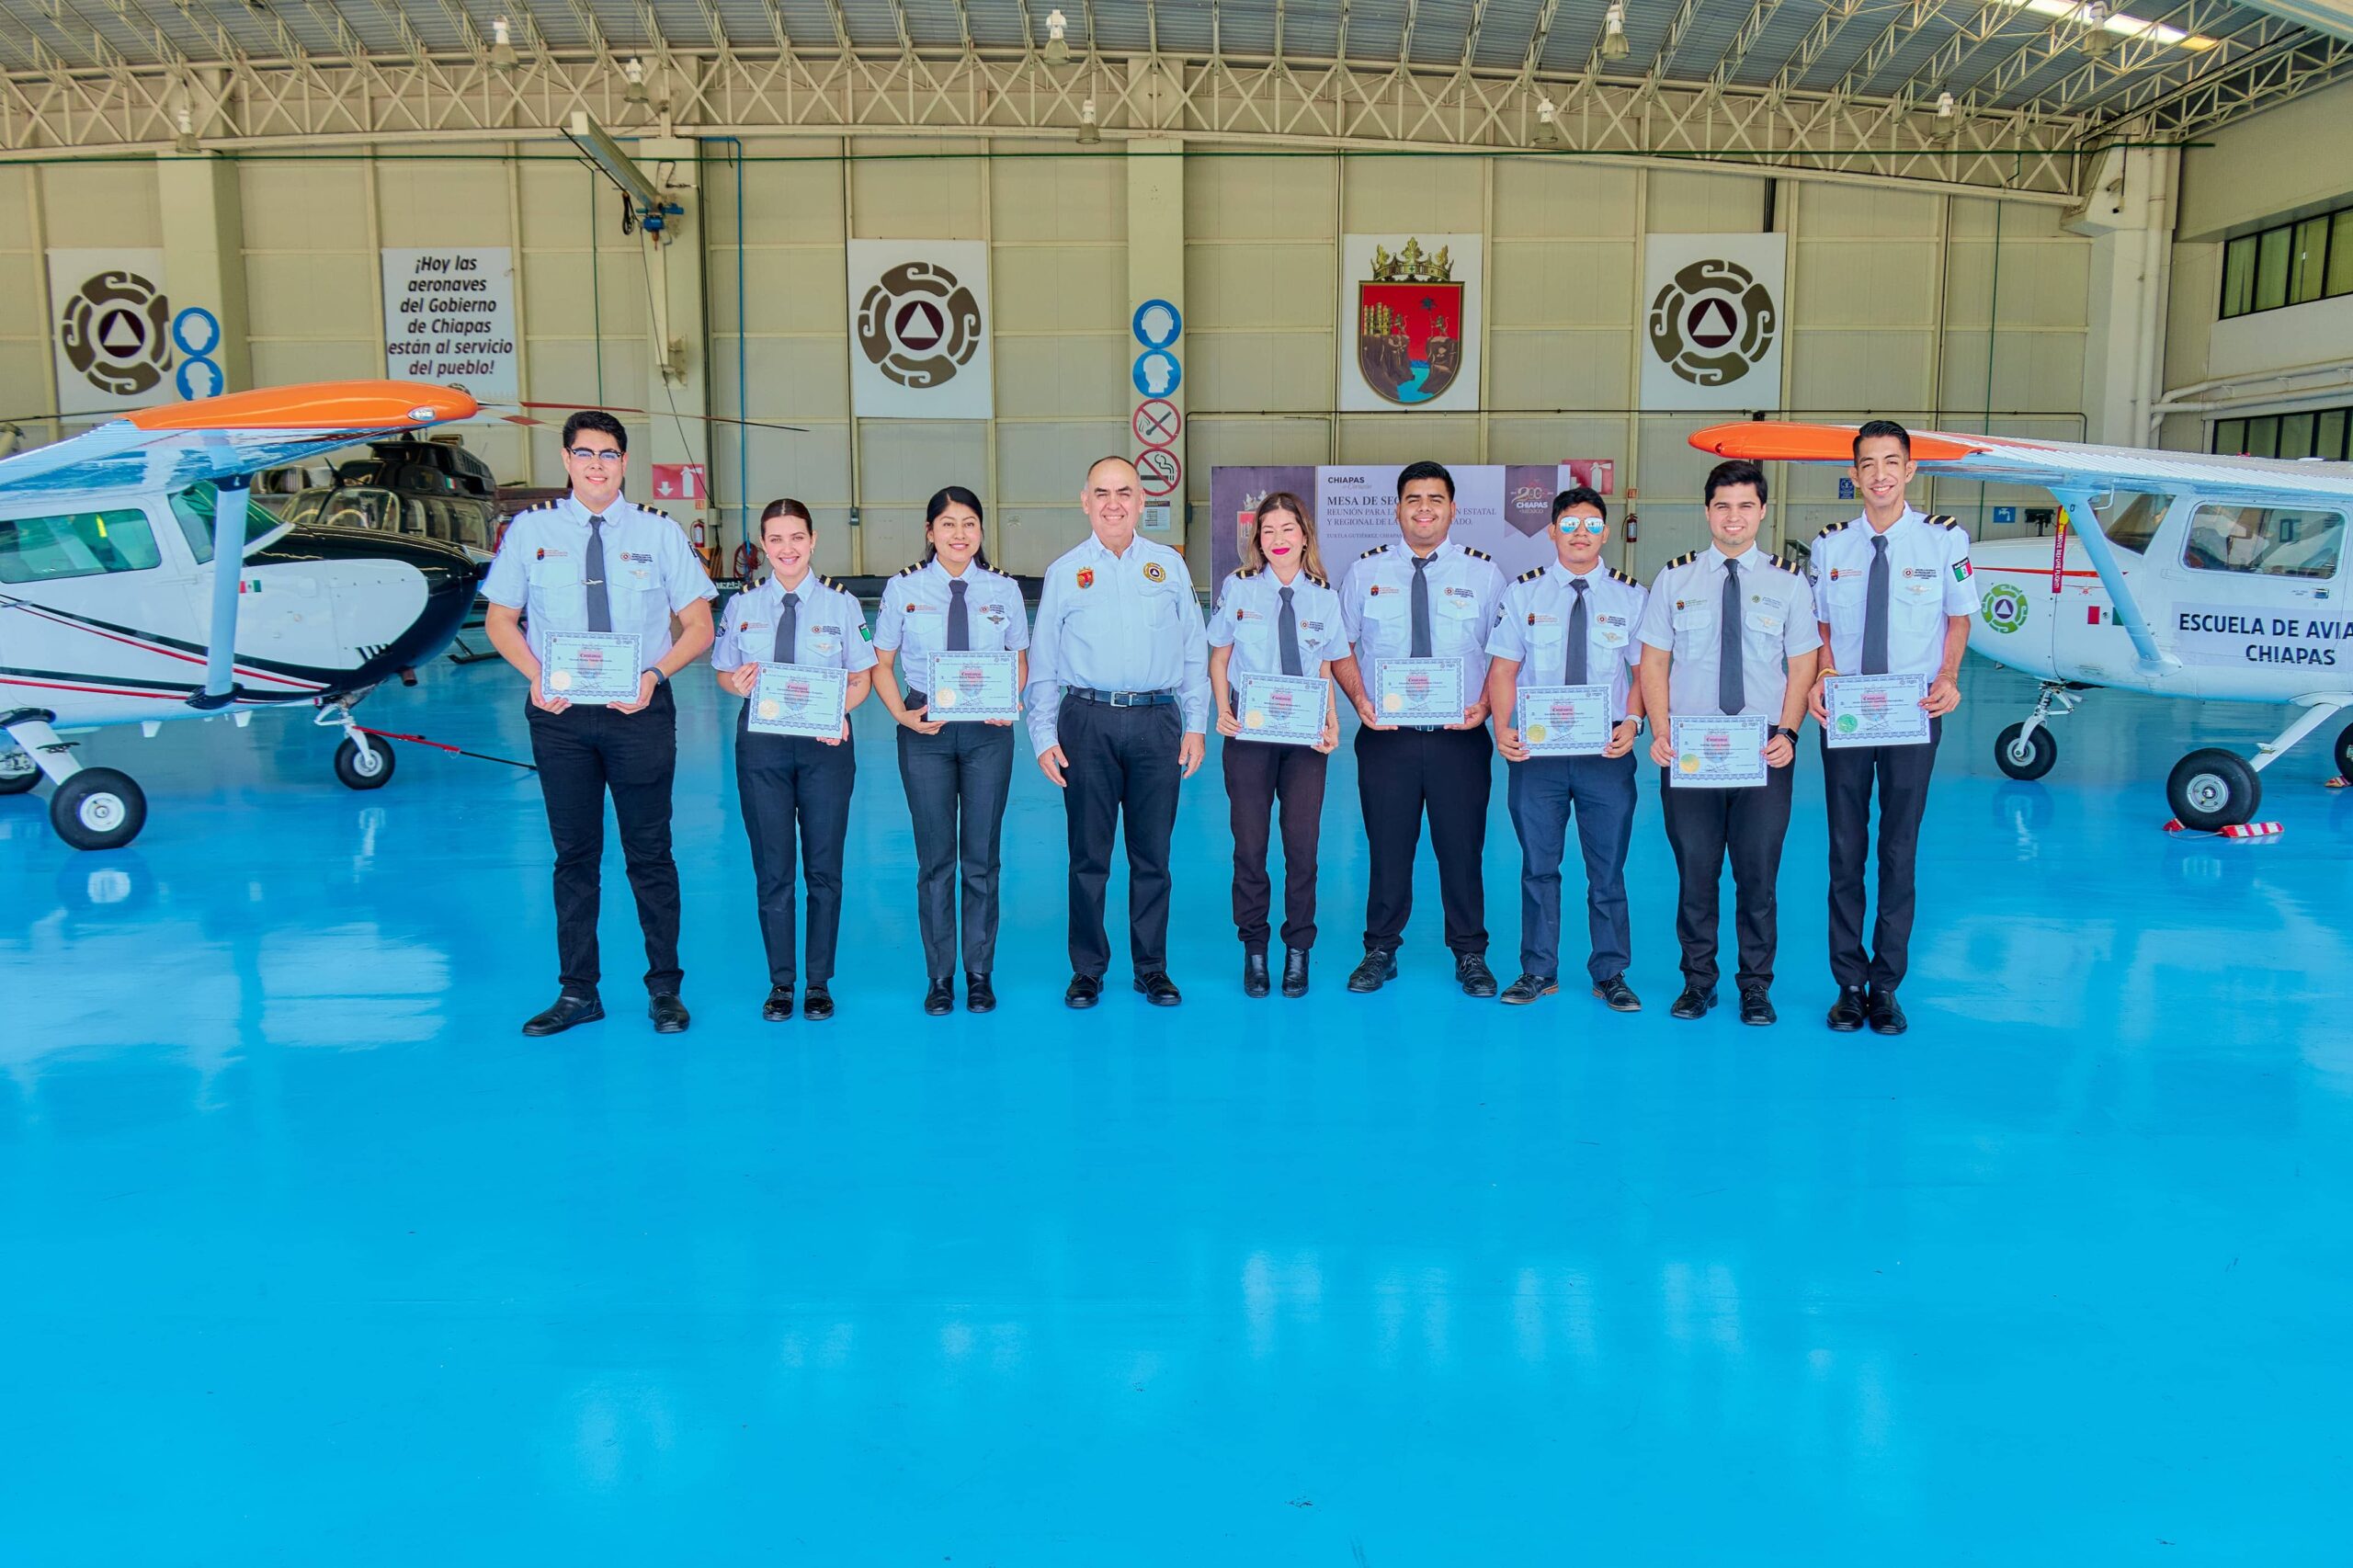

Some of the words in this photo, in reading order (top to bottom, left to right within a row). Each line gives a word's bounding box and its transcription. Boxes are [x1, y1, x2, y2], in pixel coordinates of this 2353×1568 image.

[415, 256, 450, 274] ¡Hoy
[455, 255, 477, 270] las
[408, 279, 486, 292] aeronaves
[400, 298, 424, 312] del
[429, 297, 497, 312] Gobierno
[408, 319, 426, 333] de
[432, 318, 491, 336] Chiapas
[388, 339, 430, 354] están
[436, 339, 450, 354] al
[454, 339, 512, 354] servicio
[409, 360, 432, 375] del
[437, 360, 494, 378] pueblo!
[1327, 496, 1362, 505] MESA
[1363, 496, 1378, 505] DE
[2179, 614, 2265, 635] ESCUELA
[2272, 619, 2299, 637] DE
[2306, 620, 2353, 639] AVIA
[2246, 644, 2336, 665] CHIAPAS
